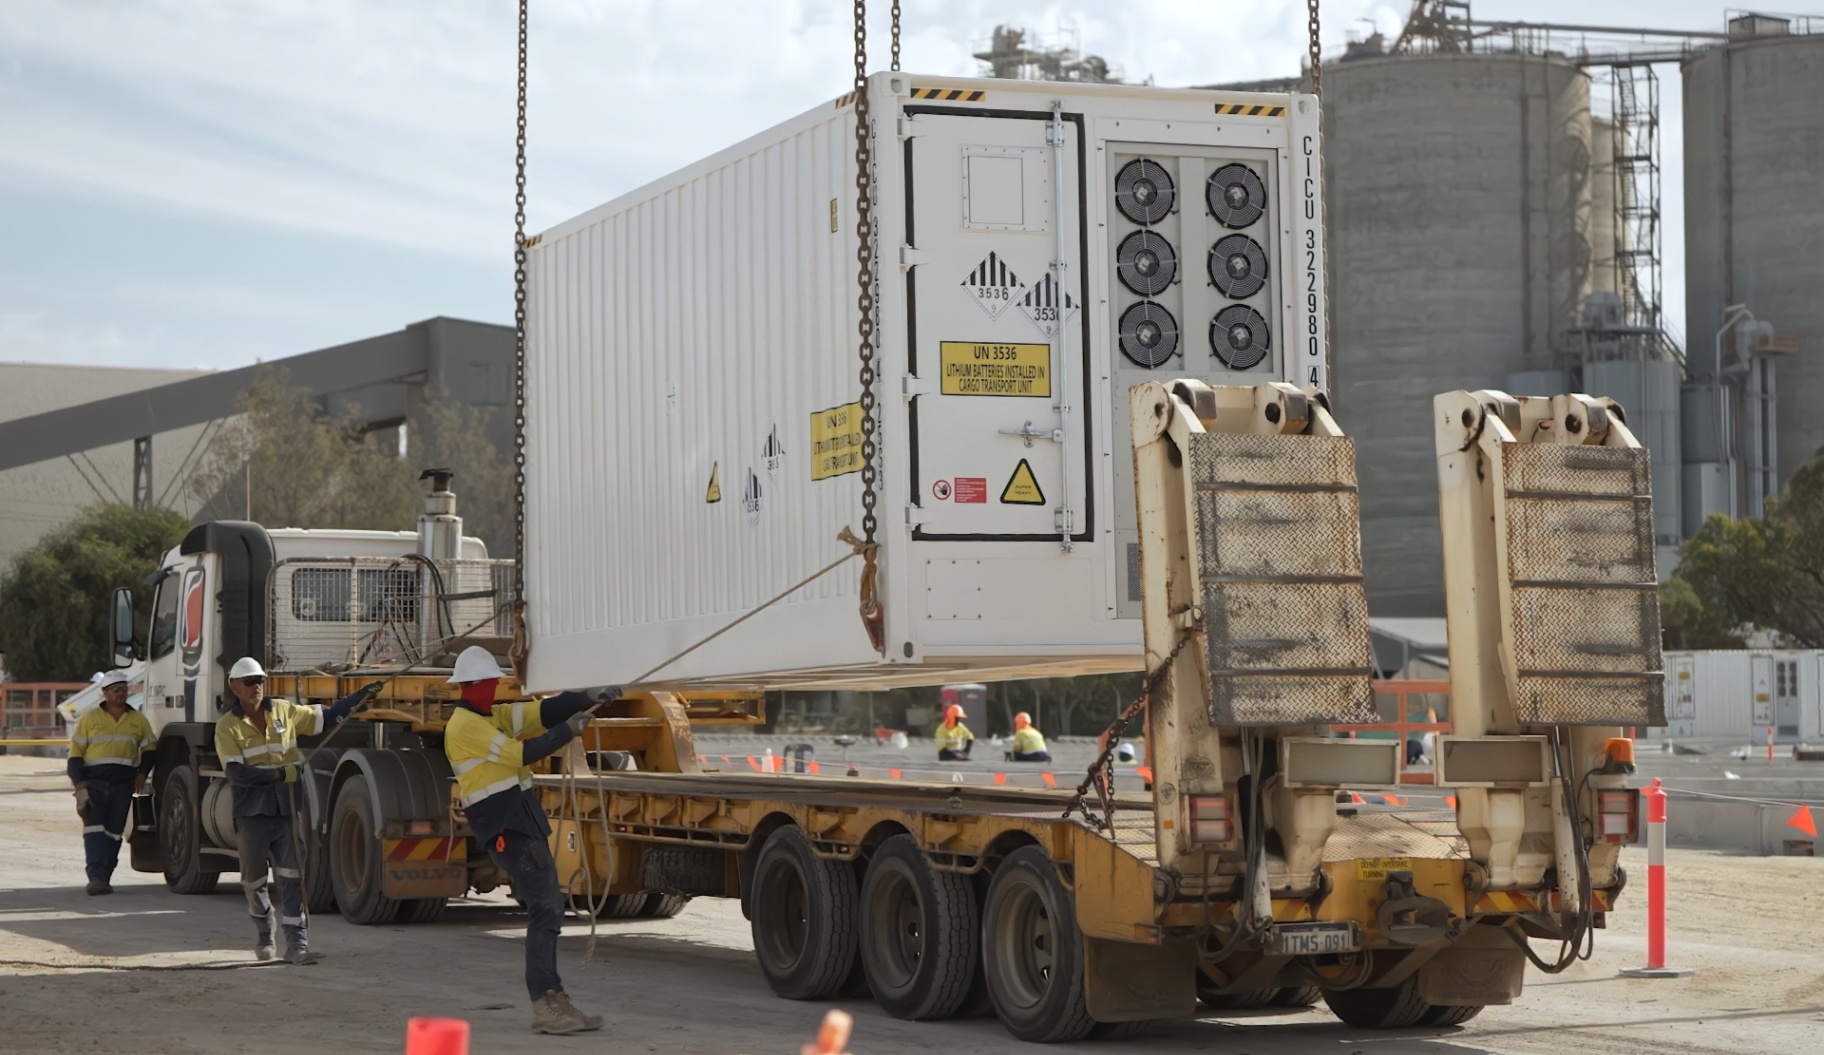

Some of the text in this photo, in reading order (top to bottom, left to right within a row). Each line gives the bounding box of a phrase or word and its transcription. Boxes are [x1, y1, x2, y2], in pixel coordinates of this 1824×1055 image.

[1302, 135, 1319, 387] CICU 322980 4
[873, 216, 881, 349] 322980
[978, 287, 1009, 301] 3536
[1045, 325, 1052, 335] 9
[974, 346, 1017, 361] UN 3536
[946, 363, 1045, 380] LITHIUM BATTERIES INSTALLED IN
[959, 378, 1033, 394] CARGO TRANSPORT UNIT
[390, 867, 460, 881] VOLVO
